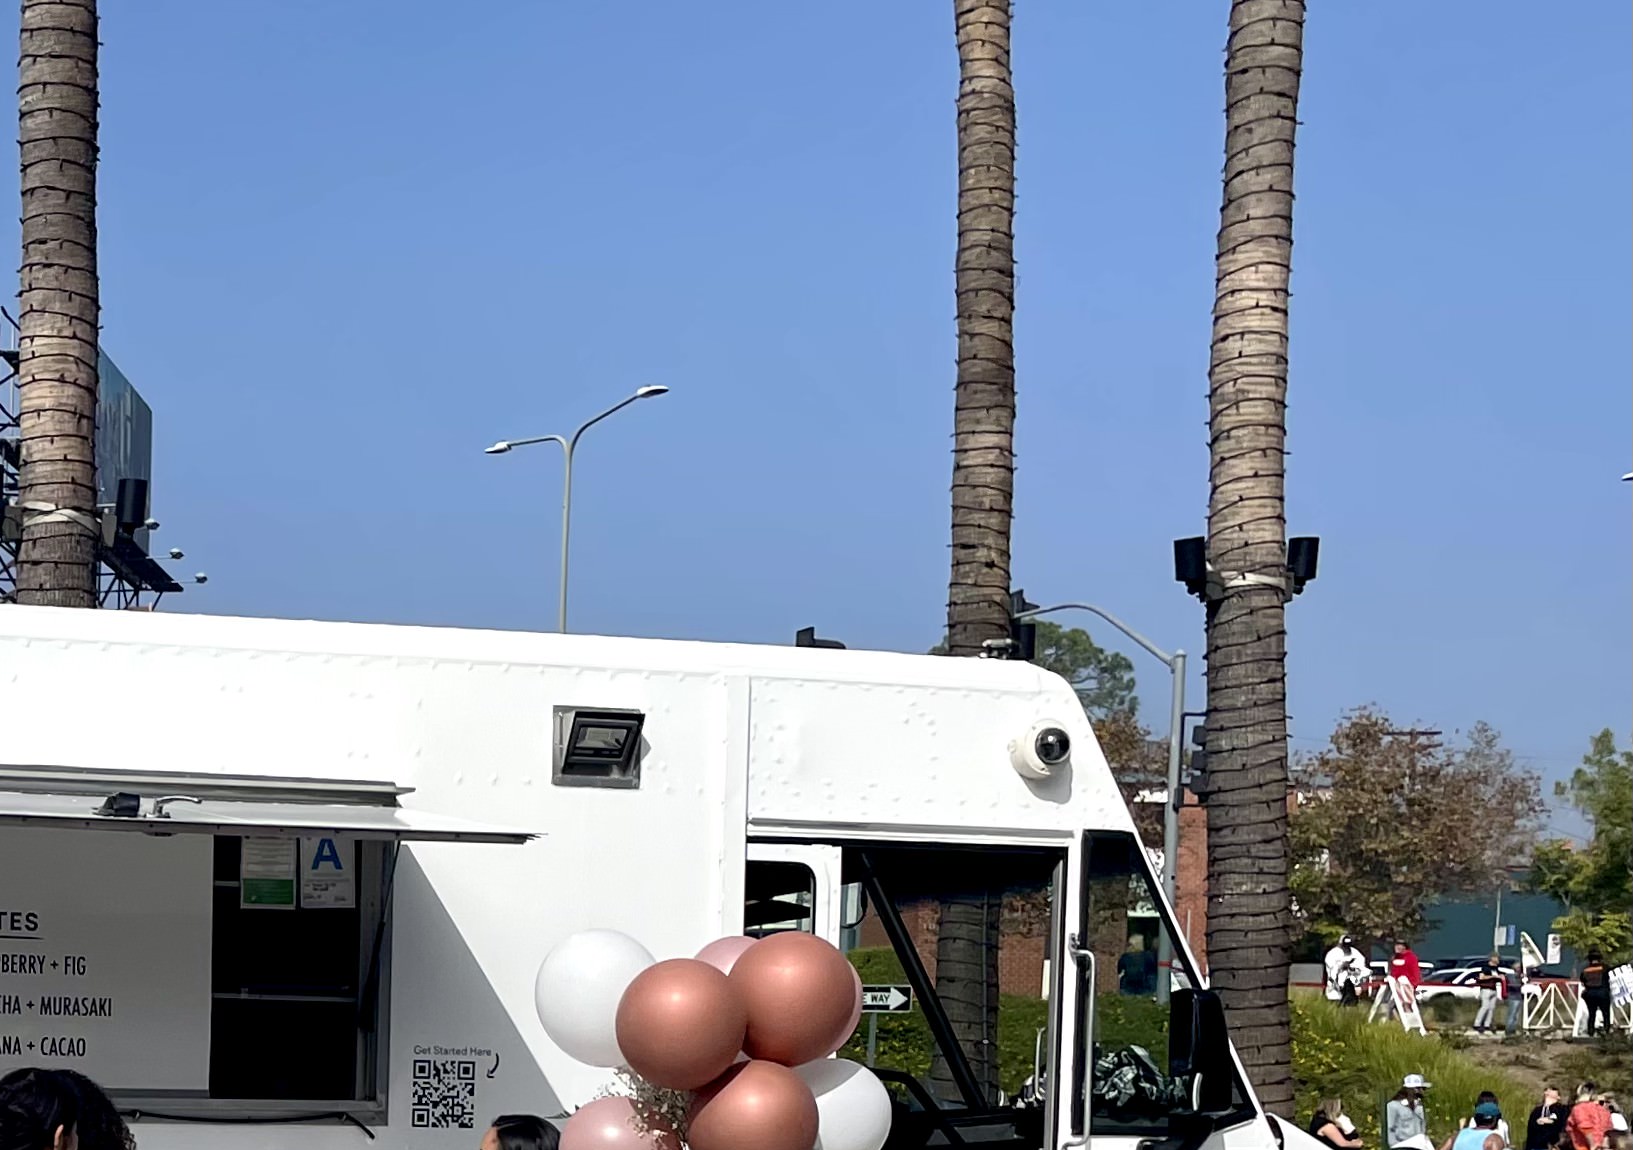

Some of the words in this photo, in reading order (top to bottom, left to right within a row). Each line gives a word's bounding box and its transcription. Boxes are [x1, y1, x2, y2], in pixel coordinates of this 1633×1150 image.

[311, 837, 344, 871] A
[49, 959, 60, 971] +
[64, 955, 87, 977] FIG
[25, 999, 36, 1010] +
[39, 995, 112, 1017] MURASAKI
[871, 994, 889, 1003] WAY
[26, 1040, 36, 1051] +
[40, 1036, 86, 1057] CACAO
[413, 1045, 431, 1055] Get
[433, 1046, 468, 1056] Started
[469, 1047, 492, 1056] Here
